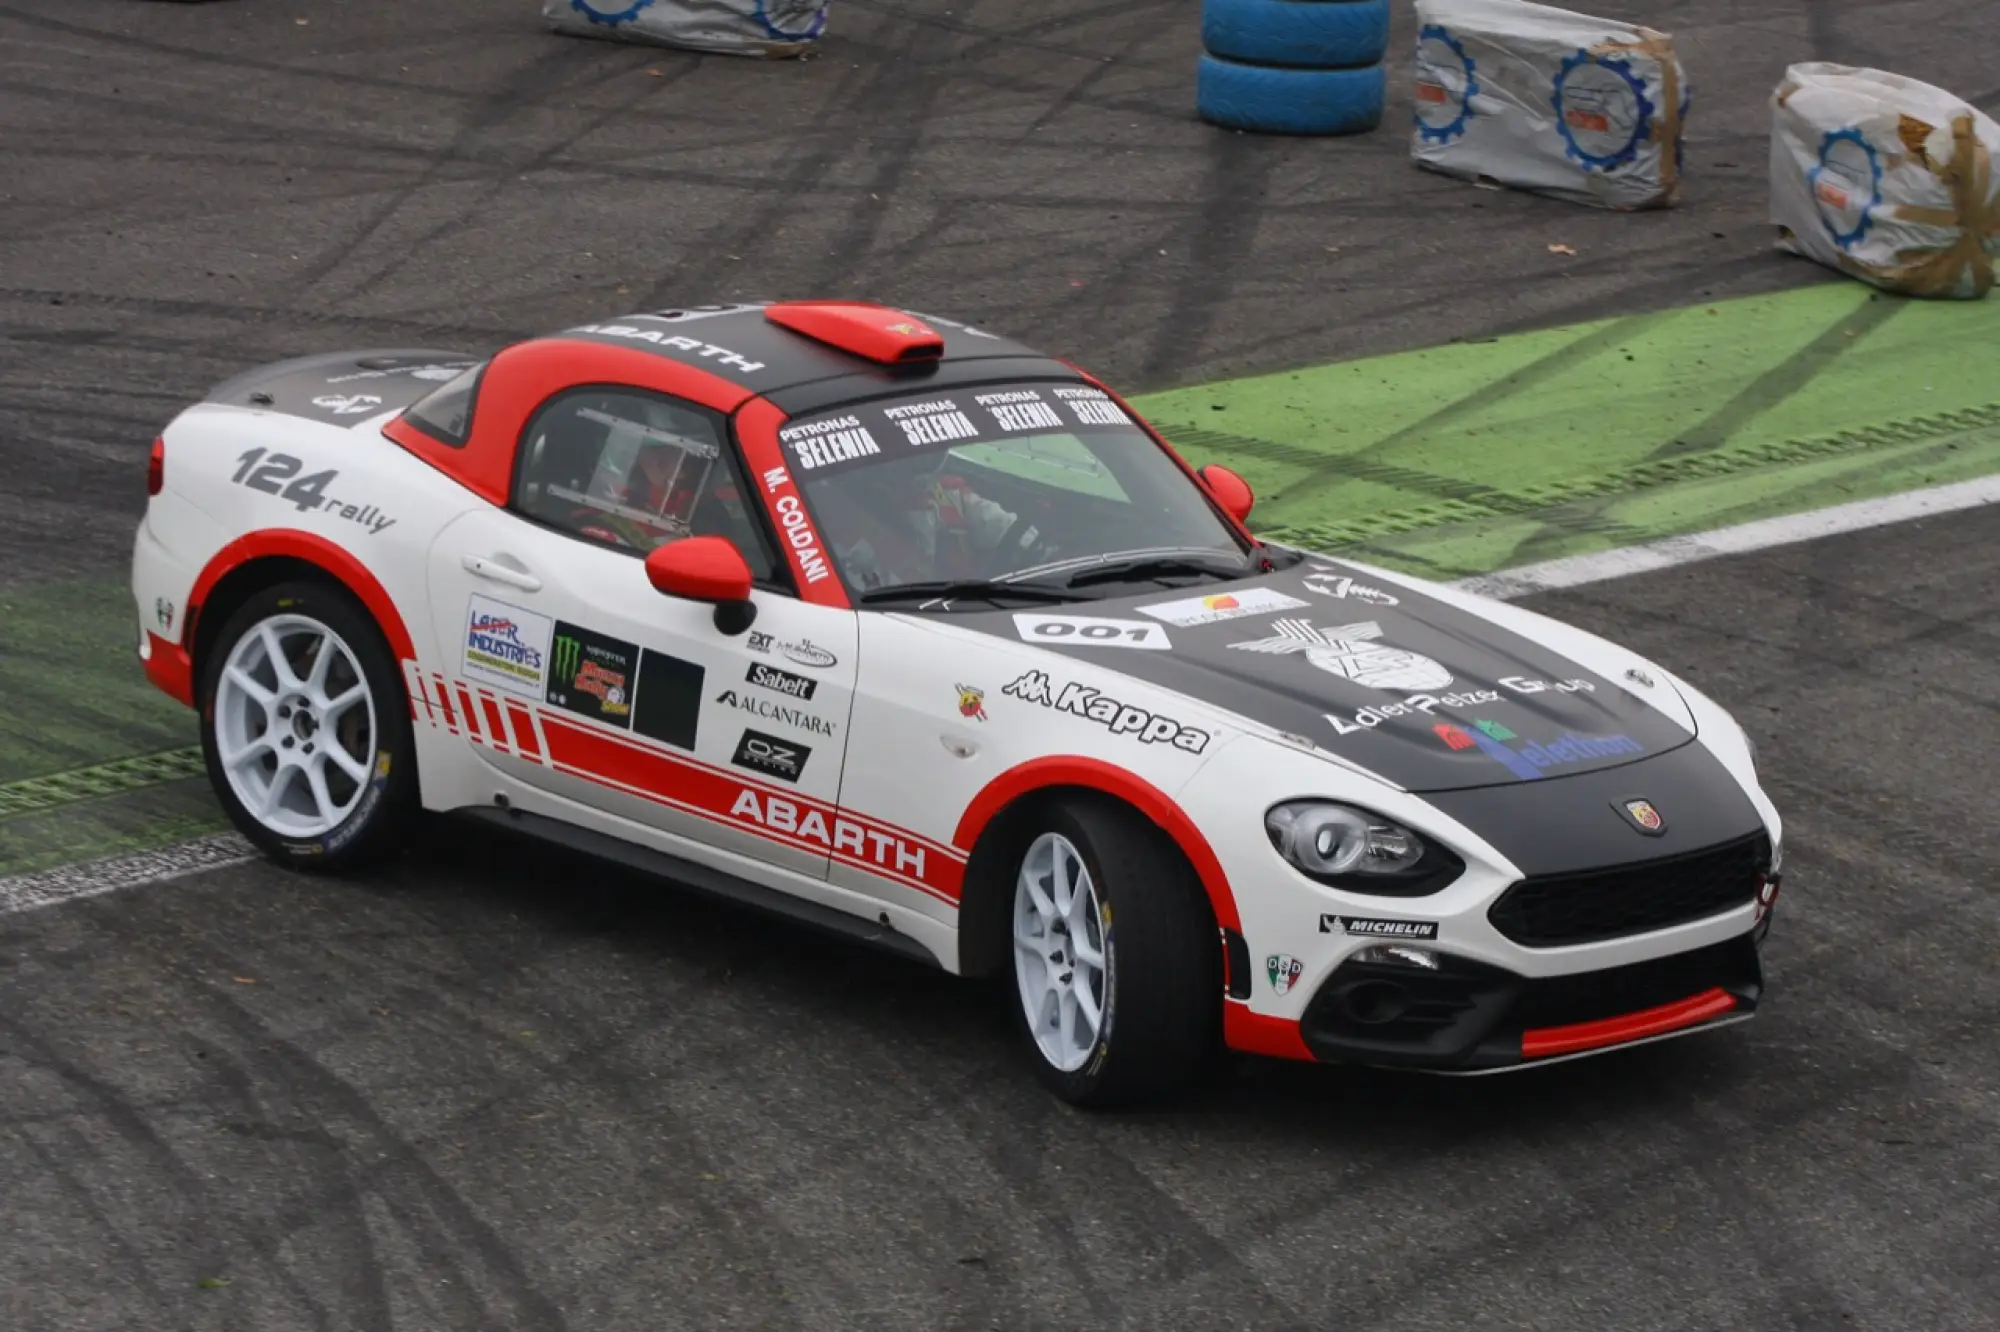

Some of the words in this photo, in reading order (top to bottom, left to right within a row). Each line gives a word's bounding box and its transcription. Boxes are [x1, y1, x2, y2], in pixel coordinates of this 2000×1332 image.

[563, 319, 766, 373] ABARTH
[883, 399, 957, 420] PETRONAS
[974, 390, 1041, 406] PETRONAS
[1052, 388, 1109, 400] PETRONAS
[779, 414, 861, 442] PETRONAS
[900, 410, 979, 446] SELENIA
[990, 401, 1064, 432] SELENIA
[1068, 400, 1134, 425] SELENIA
[794, 426, 882, 470] SELENIA
[231, 446, 339, 512] 124
[324, 494, 397, 535] rally
[763, 465, 789, 494] M.
[776, 494, 829, 585] COLDANI
[1032, 622, 1151, 643] 001
[752, 665, 810, 698] Sabelt
[739, 695, 833, 738] ALCANTARA
[1055, 681, 1210, 755] Kappa
[747, 738, 797, 765] OZ
[730, 788, 925, 878] ABARTH
[1350, 919, 1433, 935] MICHELIN
